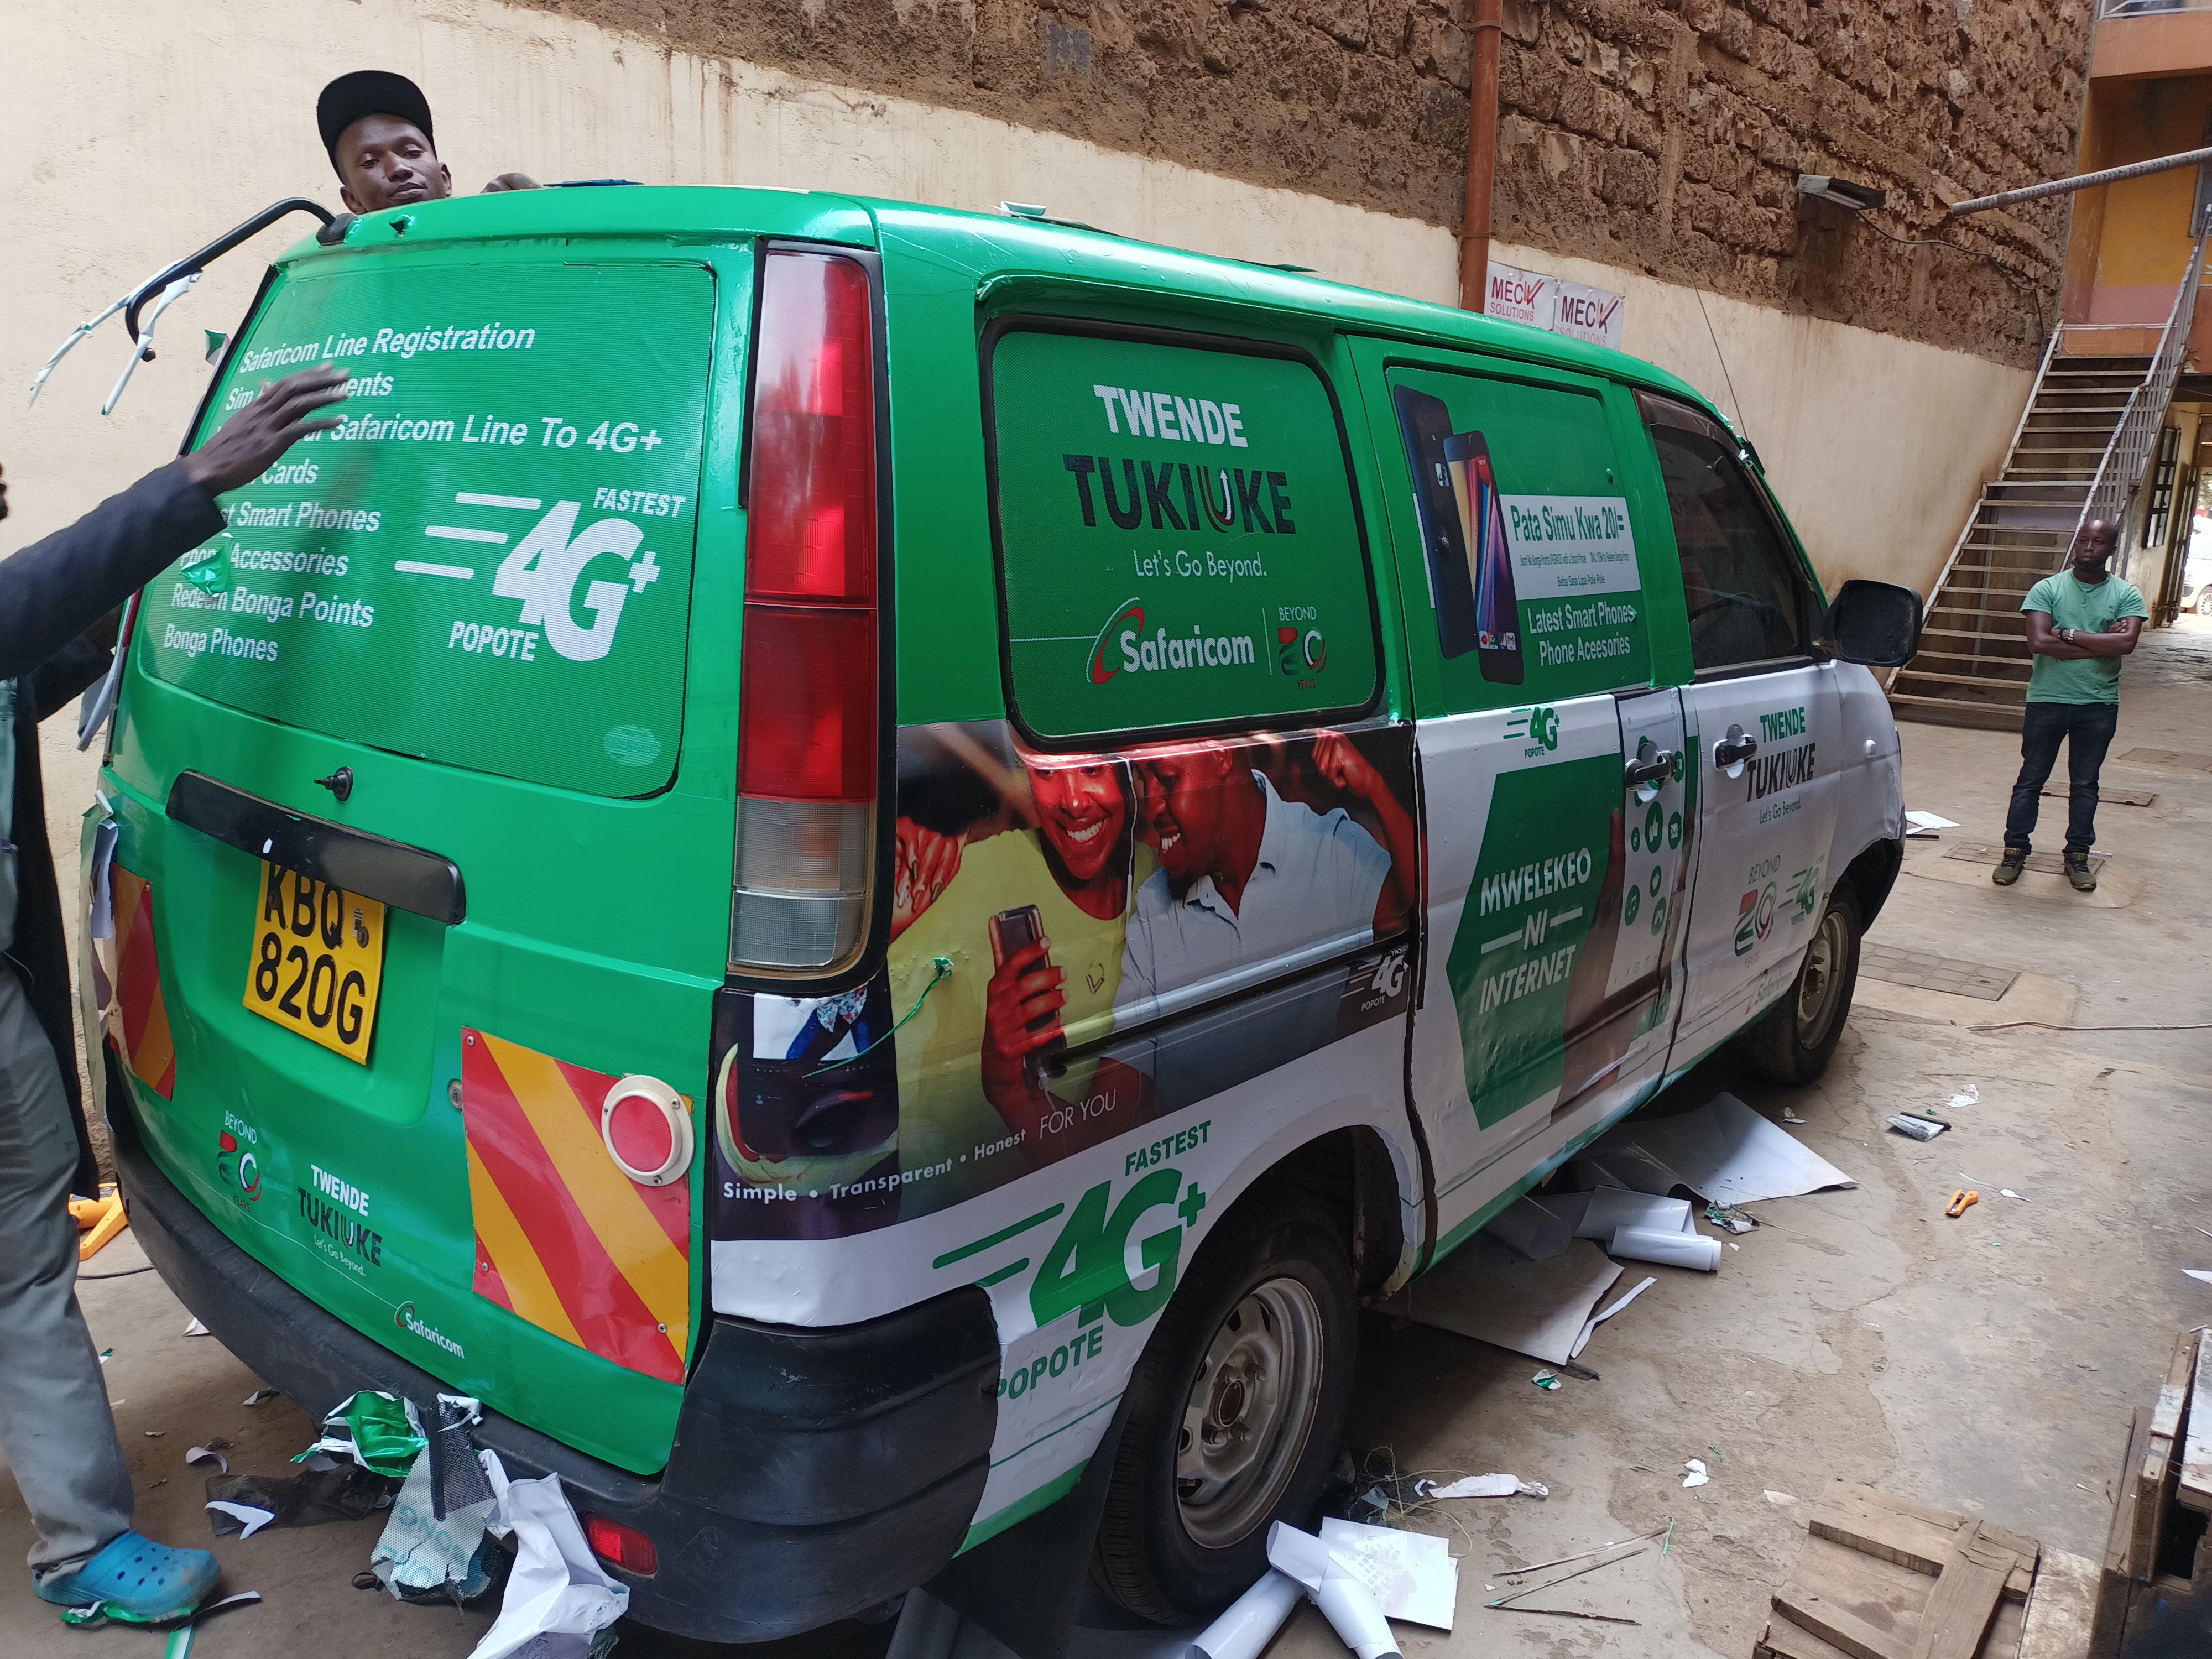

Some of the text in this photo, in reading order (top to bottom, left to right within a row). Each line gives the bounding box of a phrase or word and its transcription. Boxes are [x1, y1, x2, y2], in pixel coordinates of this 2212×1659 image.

[1490, 302, 1535, 322] SOLUTIONS
[1491, 276, 1545, 310] MECK
[1561, 295, 1619, 334] MECK
[239, 322, 536, 374] Safaricom Line Registration
[225, 387, 254, 411] Sim
[1093, 384, 1248, 448] TWENDE
[330, 413, 455, 441] Safaricom
[462, 414, 528, 445] Line
[541, 417, 577, 448] To
[587, 421, 662, 453] 4G+
[262, 458, 319, 484] Cards
[593, 487, 686, 518] FASTEST
[1062, 453, 1296, 534] TUKIUKE
[237, 501, 293, 527] Smart
[295, 502, 382, 532] Phones
[1510, 505, 1625, 541] Pata Simu Kwa 20/=
[231, 543, 349, 576] Accessories
[1133, 550, 1267, 583] Let's Go Beyond.
[492, 500, 661, 661] 4G+
[232, 586, 294, 623] Bonga
[298, 591, 374, 628] Points
[1279, 606, 1317, 621] BEYOND
[1527, 601, 1635, 634] Latest Smart Phones
[164, 623, 279, 662] Bonga Phones
[448, 621, 539, 661] POPOTE
[1120, 624, 1255, 672] Safaricom
[1539, 631, 1630, 667] Phone Aceesories
[1530, 706, 1559, 751] 4G+
[1760, 707, 1806, 743] TWENDE
[1525, 746, 1545, 758] POPOTE
[1747, 742, 1815, 802] TUKIUKE
[1760, 806, 1771, 824] Let's
[1772, 804, 1781, 819] Go
[1480, 847, 1591, 917] MWELEKEO
[1747, 855, 1780, 885] BEYOND
[264, 863, 344, 950] KBQ
[1524, 909, 1548, 951] NI
[255, 932, 366, 1045] 820G
[1479, 943, 1576, 1015] INTERNET
[1361, 995, 1385, 1011] POPOTE
[225, 1110, 257, 1144] BEYOND
[723, 1089, 1117, 1204] Simple Transparent Honest FOR YOU
[1125, 1120, 1211, 1177] FASTEST
[311, 1164, 369, 1217] TWENDE
[297, 1185, 382, 1267] TUKIUKE
[314, 1234, 366, 1276] Let's Go Beyond.
[1029, 1168, 1206, 1329] 4G+
[405, 1312, 465, 1359] Safaricom
